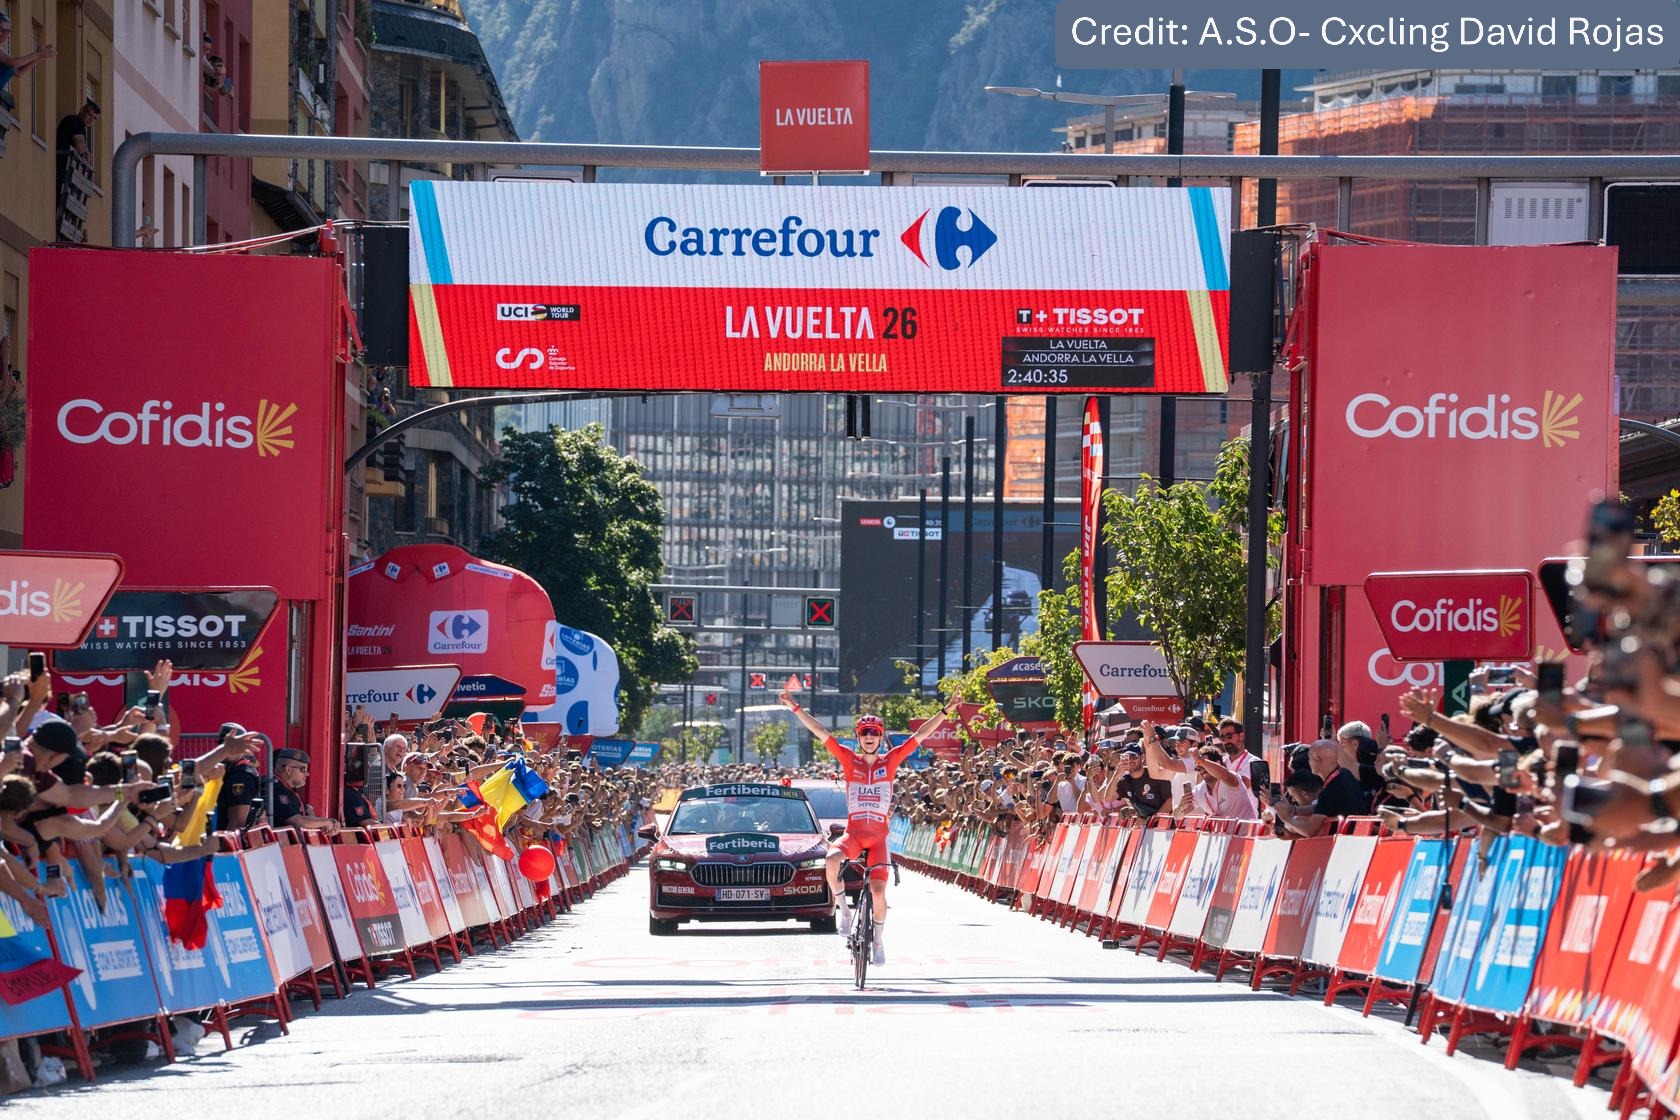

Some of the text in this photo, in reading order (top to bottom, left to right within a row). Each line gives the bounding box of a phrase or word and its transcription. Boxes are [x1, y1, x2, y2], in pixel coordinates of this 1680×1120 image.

[776, 107, 853, 126] LA VUELTA
[644, 215, 880, 258] Carrefour
[501, 306, 529, 317] UCI
[1052, 307, 1145, 325] TISSOT
[725, 305, 917, 340] LA VUELTA 26
[1016, 326, 1044, 334] SWISS
[1047, 326, 1089, 334] WATCHES
[1093, 326, 1120, 334] SINCE
[1050, 339, 1108, 350] LA VUELTA
[763, 352, 888, 373] ANDORRA LA VELLA
[1022, 353, 1134, 364] ANDORRA LA VELLA
[1007, 369, 1069, 384] 2:40:35
[1345, 392, 1540, 441] Cofidis
[56, 398, 255, 449] Cofidis
[1390, 598, 1500, 633] Cofidis
[122, 614, 247, 638] TISSOT
[348, 624, 396, 637] Santini
[80, 640, 247, 650] WISS WATCHES SINCE 1853
[354, 645, 382, 656] VUELTA
[433, 640, 482, 651] Carrefour
[1099, 664, 1167, 678] Carrefou
[457, 681, 486, 692] lvetia
[346, 689, 400, 704] rrefour
[591, 744, 622, 752] OTERÍAS
[705, 785, 780, 797] Fertiberia
[858, 786, 881, 795] UAE
[709, 838, 776, 850] Fertiberia
[722, 888, 764, 899] HD-071-SV
